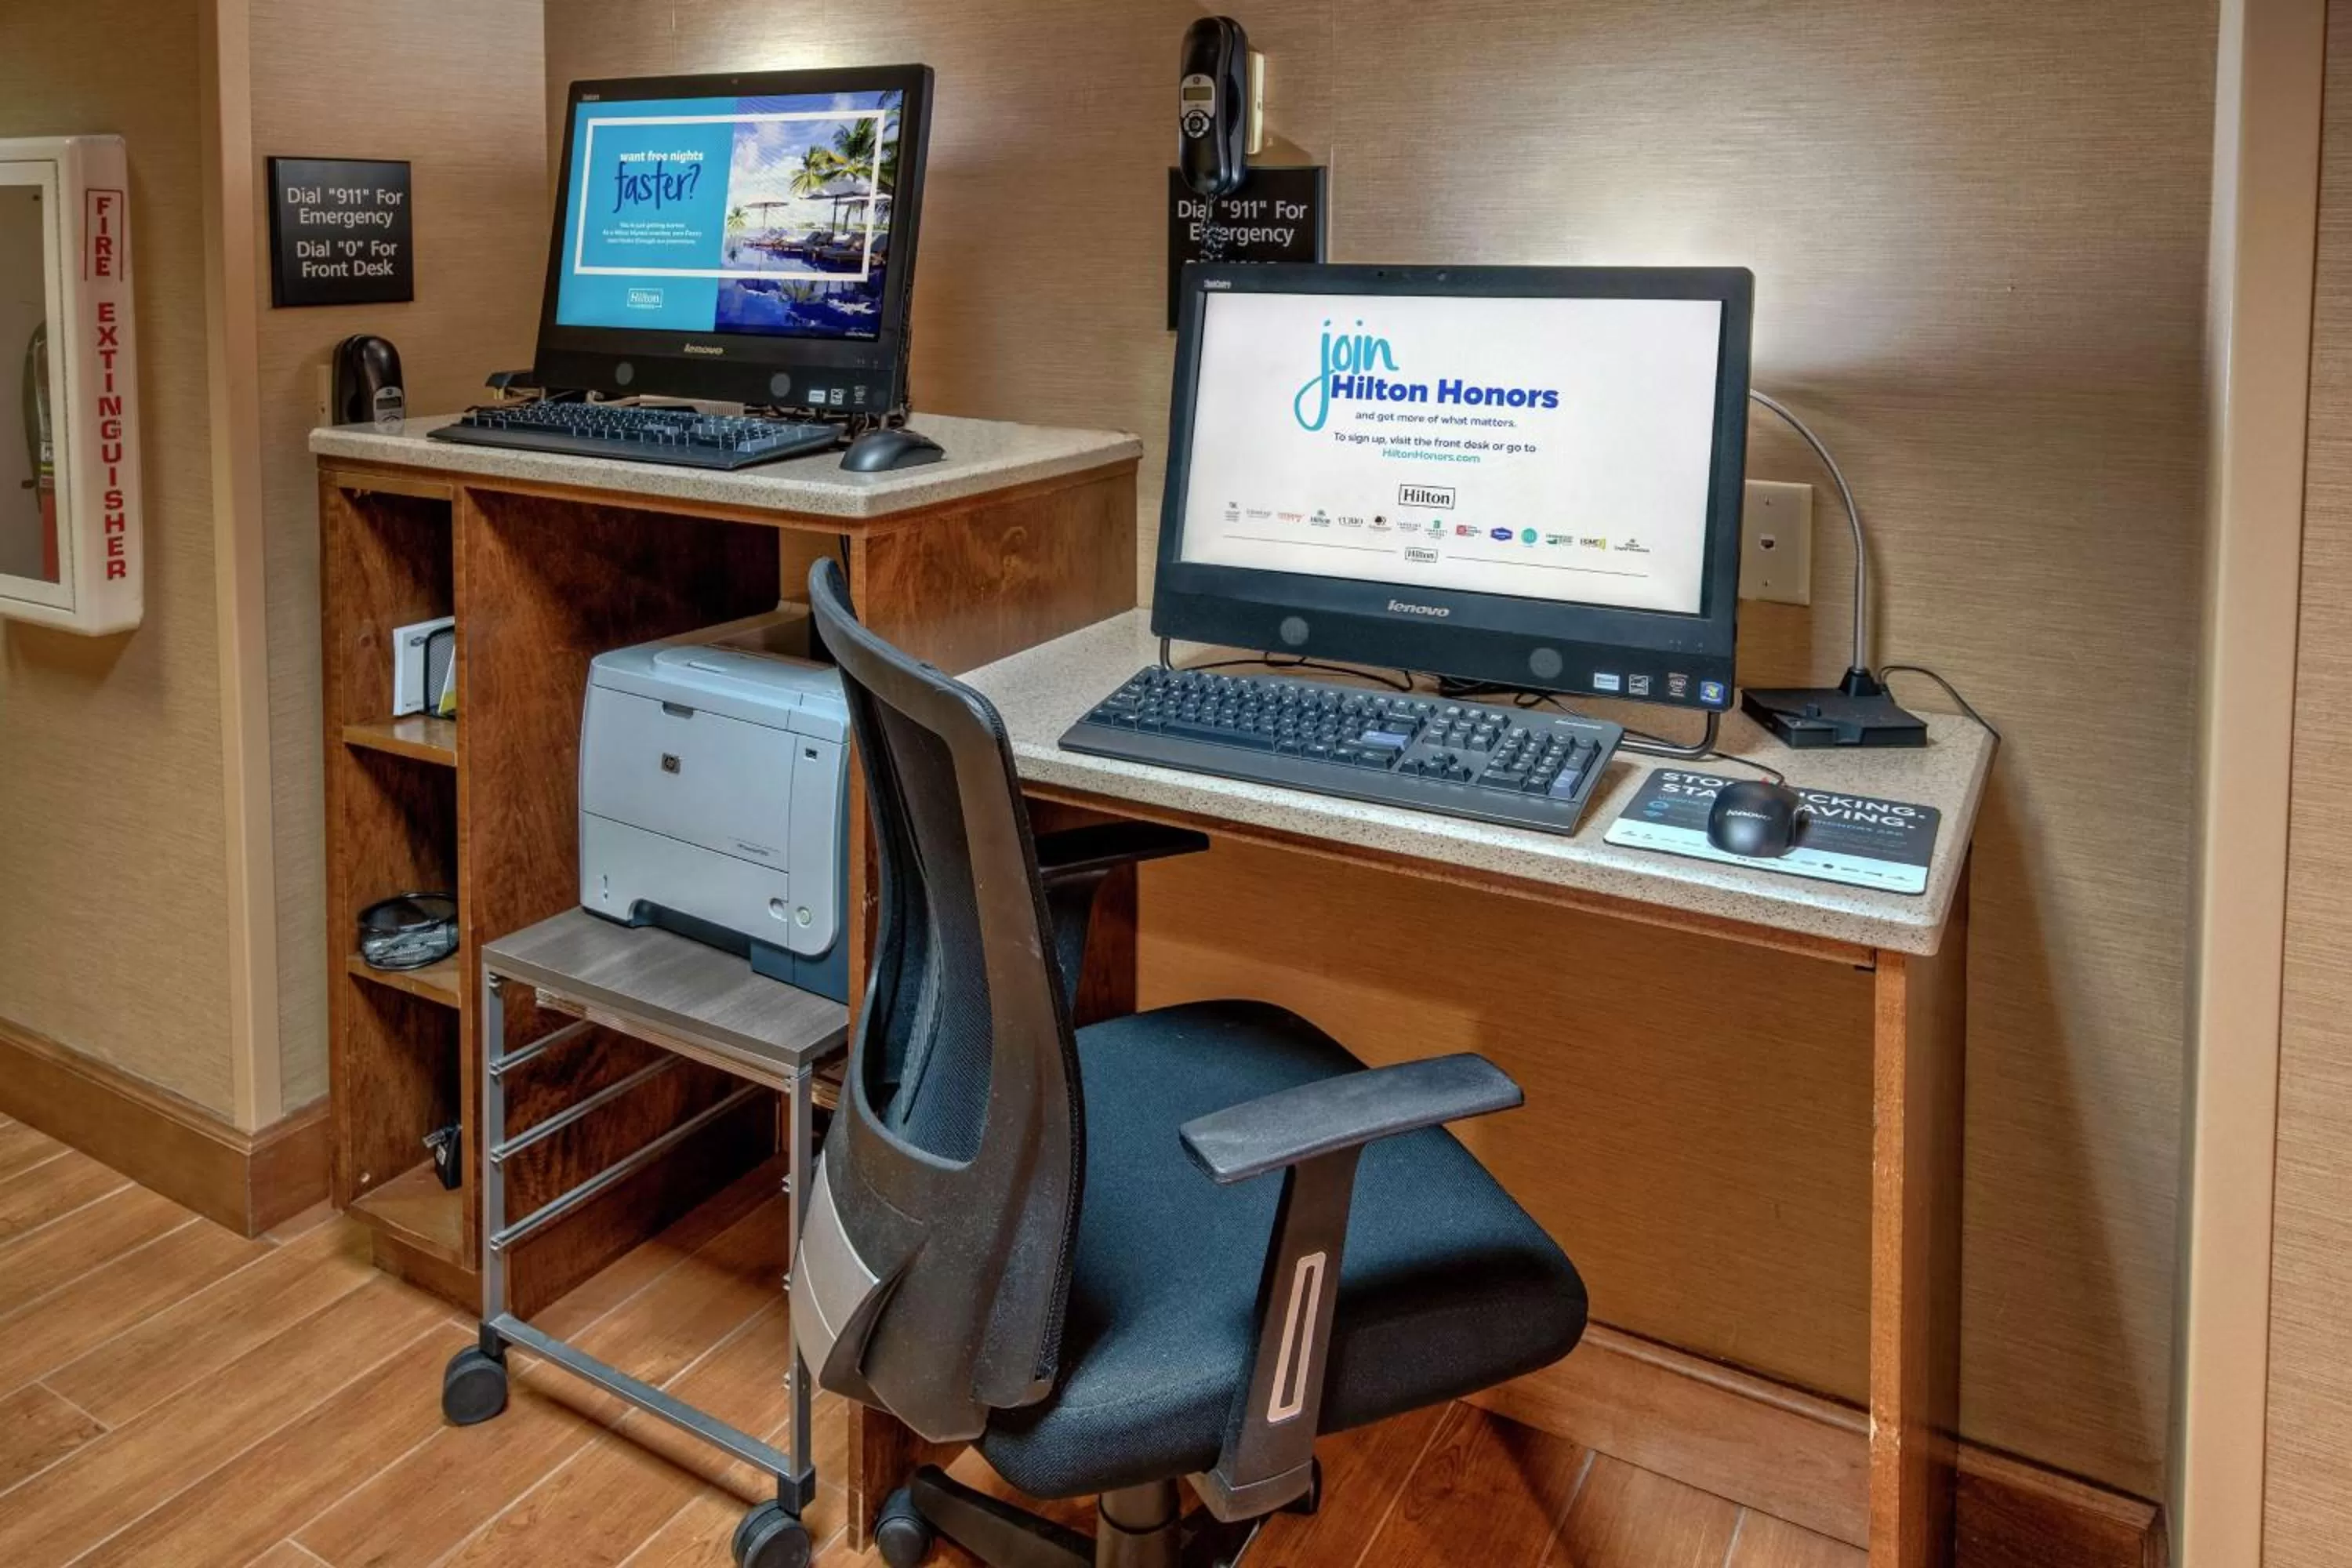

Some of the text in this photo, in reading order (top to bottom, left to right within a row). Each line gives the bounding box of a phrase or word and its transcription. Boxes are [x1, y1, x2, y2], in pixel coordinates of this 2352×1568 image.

[620, 151, 704, 163] want free nights
[287, 187, 403, 205] Dial "911" For
[612, 160, 702, 213] faster?
[299, 208, 394, 228] Emergency
[1221, 201, 1267, 220] "911"
[1276, 201, 1308, 220] For
[1189, 223, 1294, 247] Eergency
[296, 241, 397, 258] Dial "0" For
[302, 259, 394, 278] Front Desk
[630, 292, 659, 303] Hilton
[1294, 319, 1399, 431] join
[95, 197, 127, 580] FIRE EXTINGUISHER
[1330, 374, 1559, 408] Hilton Honors
[1355, 411, 1375, 420] and
[1377, 412, 1394, 422] get
[1428, 415, 1439, 423] of
[1440, 416, 1468, 425] what
[1470, 418, 1517, 428] matters.
[1334, 432, 1346, 441] To
[1348, 433, 1370, 444] sign
[1390, 435, 1411, 445] visit
[1414, 437, 1432, 447] the
[1434, 437, 1461, 448] front
[1464, 440, 1490, 450] desk
[1492, 443, 1504, 452] or
[1506, 444, 1522, 454] go
[1524, 444, 1537, 453] to
[1382, 448, 1481, 463] HiltonHonors.com
[1404, 488, 1450, 504] Hilton
[1661, 784, 1717, 799] STA
[1794, 804, 1916, 829] AVING.
[1798, 791, 1926, 819] CKING.
